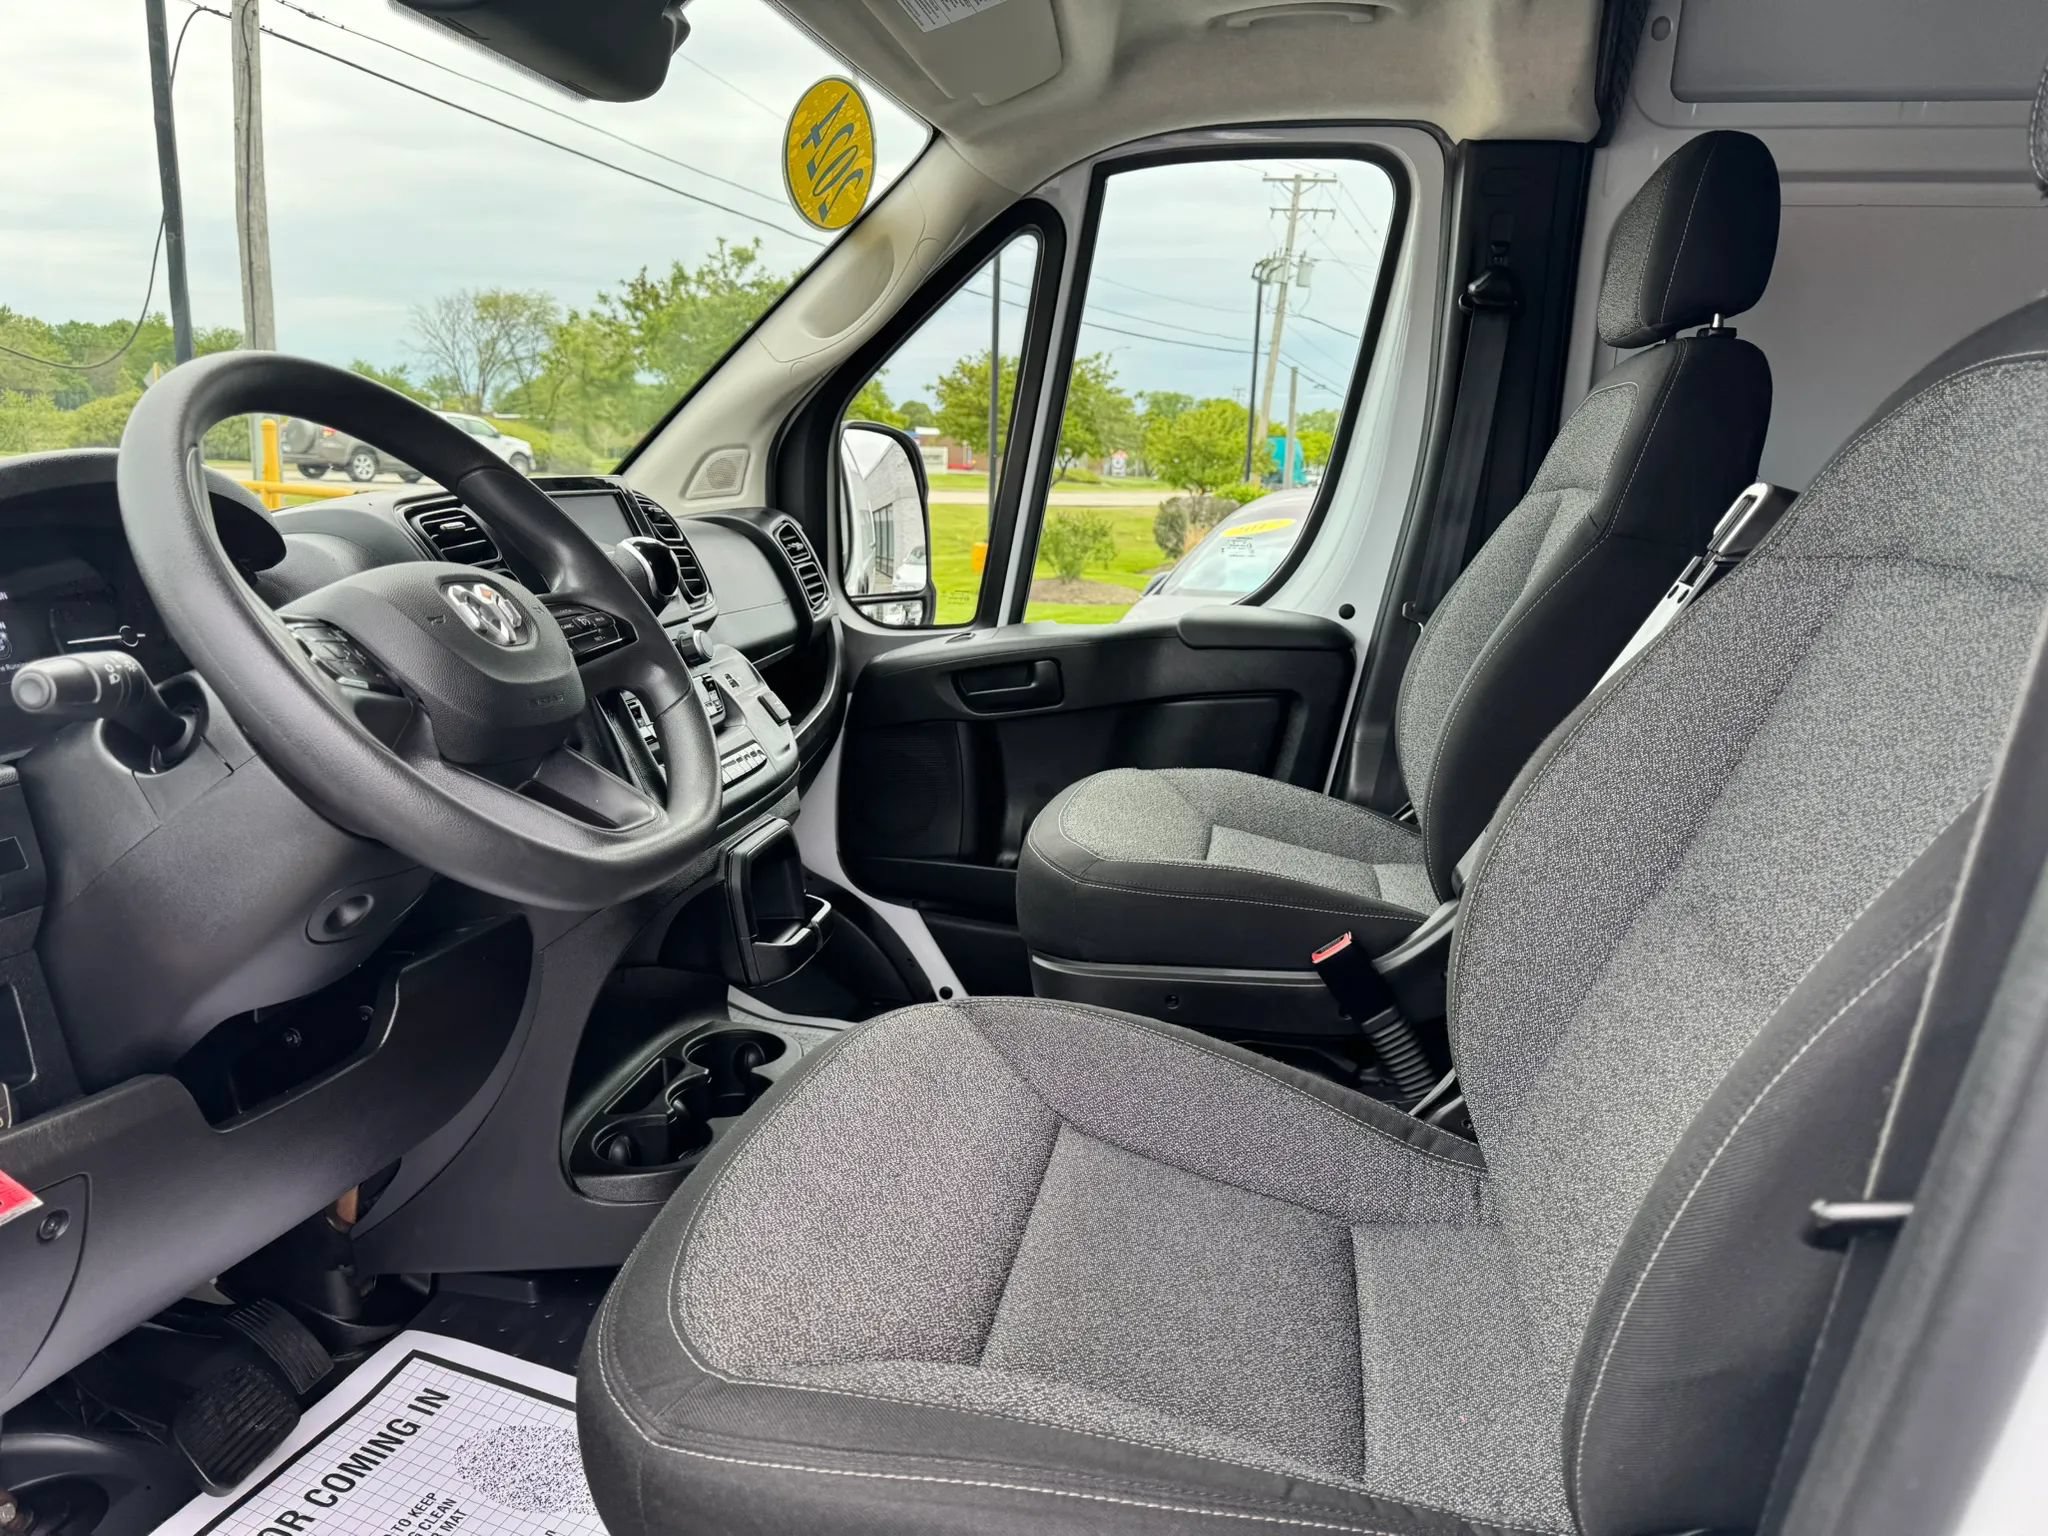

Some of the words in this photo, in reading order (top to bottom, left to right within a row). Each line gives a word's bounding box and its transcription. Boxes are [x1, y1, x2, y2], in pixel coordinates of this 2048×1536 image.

[303, 1418, 422, 1508] COMING
[407, 1387, 451, 1417] IN
[390, 1518, 412, 1532] TO
[407, 1492, 437, 1518] KEEP
[418, 1498, 457, 1531] CLEAN
[440, 1508, 467, 1532] MAT
